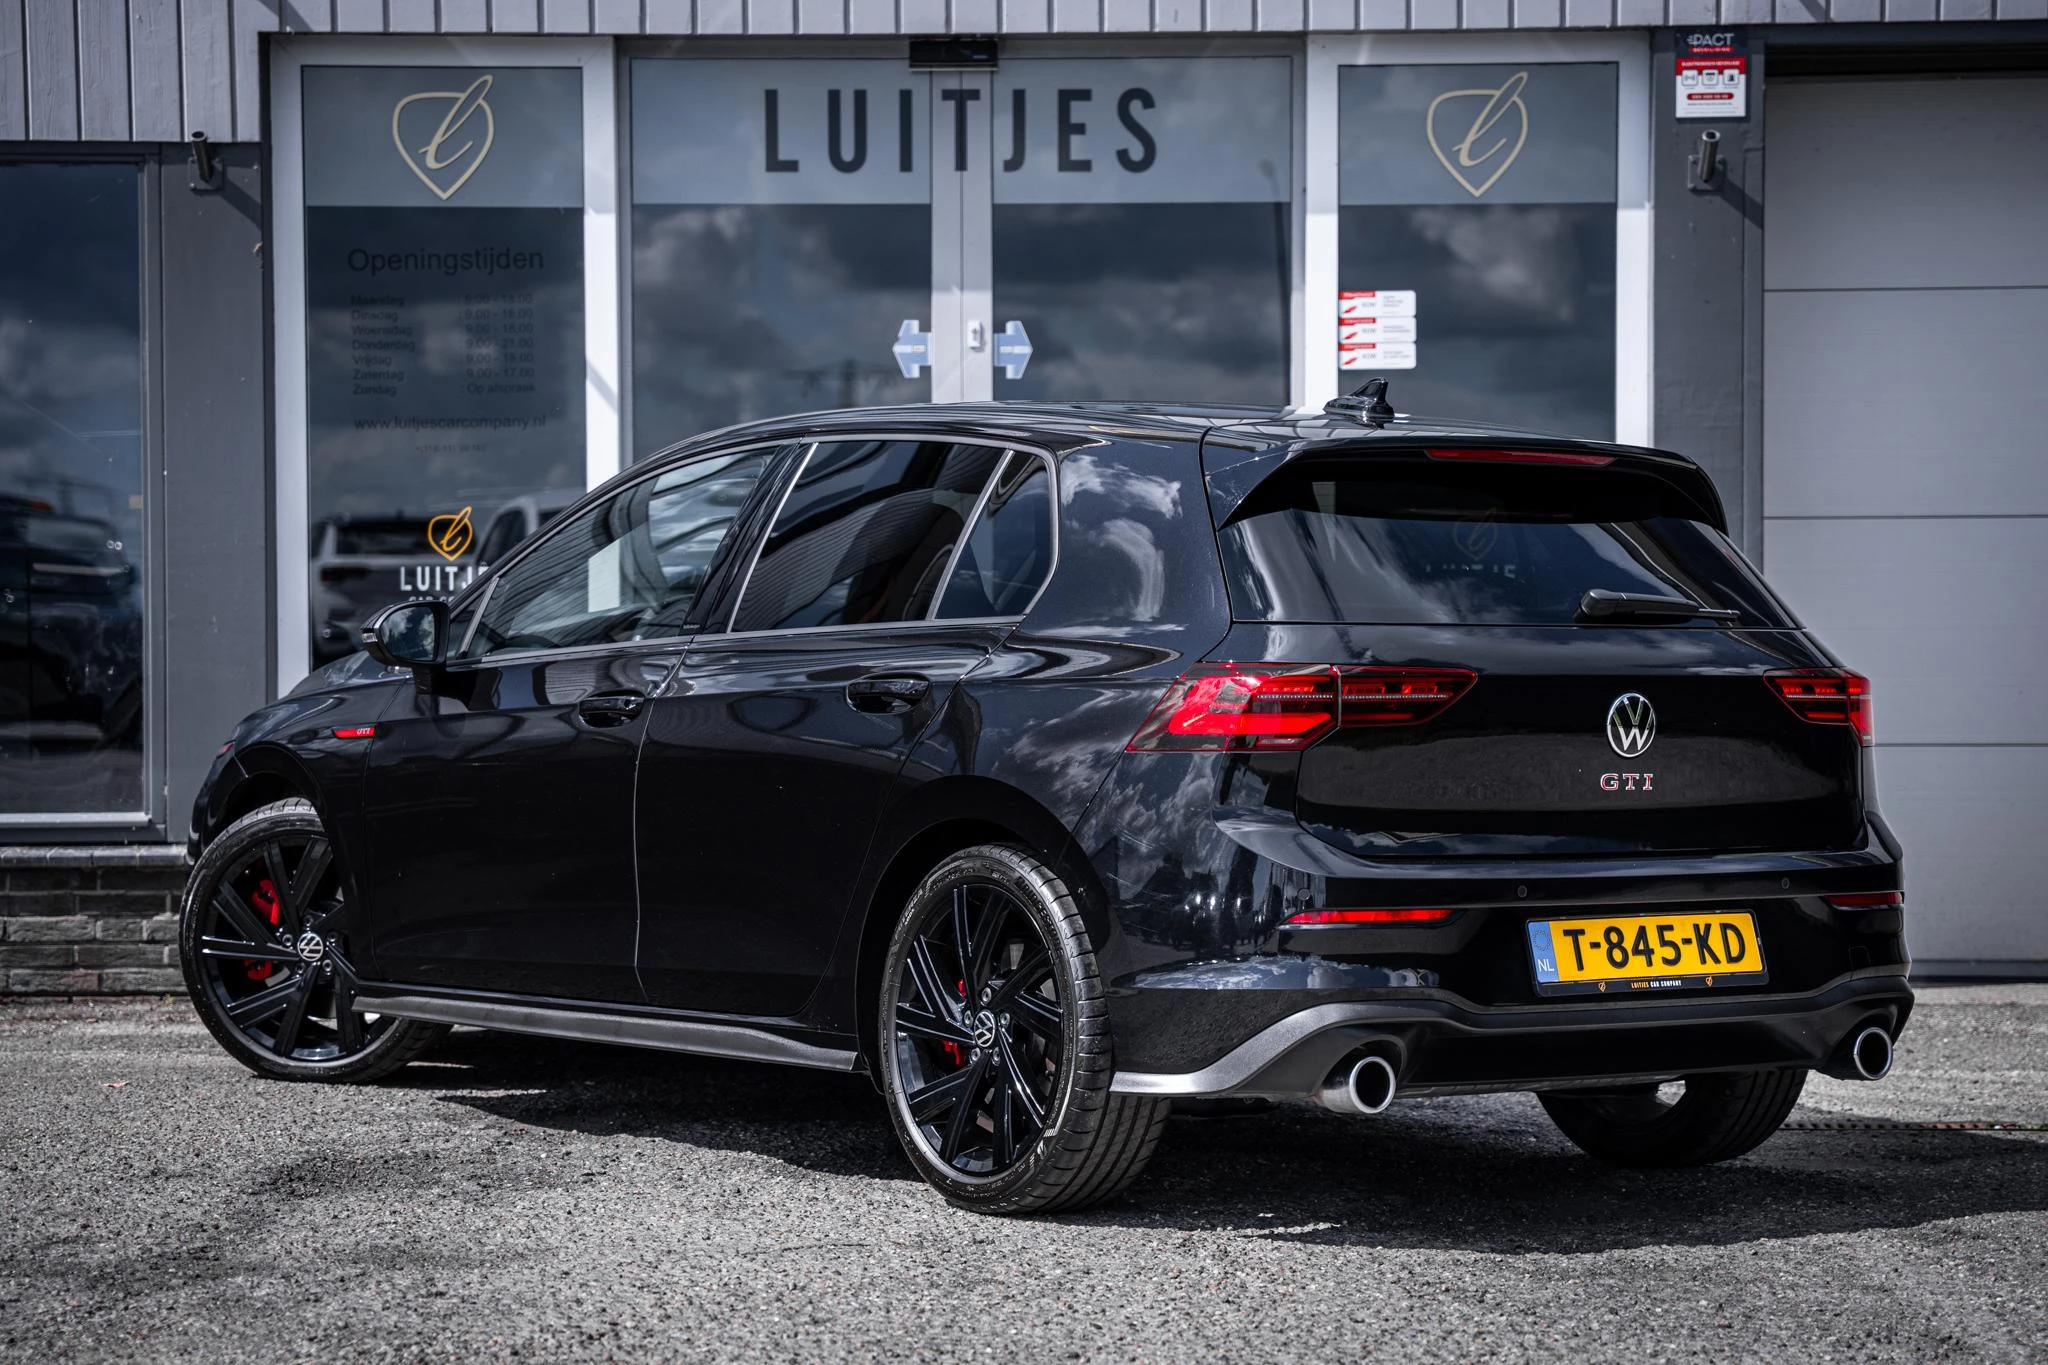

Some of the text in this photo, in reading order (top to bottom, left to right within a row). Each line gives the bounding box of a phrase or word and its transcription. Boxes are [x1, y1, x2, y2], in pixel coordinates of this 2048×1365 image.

[764, 88, 1156, 174] LUITJES
[347, 246, 545, 276] Openingstijden
[351, 309, 398, 322] Dinsdag
[352, 325, 413, 337] Woensdag
[352, 340, 416, 353] Donderdag
[352, 355, 392, 367] Vrijdag
[353, 370, 405, 382] Zaterdag
[353, 384, 397, 397] Zondag
[353, 414, 546, 432] www.luitjescarcompany.nl
[400, 565, 490, 592] LUITJ
[1600, 773, 1654, 791] GTI
[1562, 922, 1747, 972] T-845-KD
[1537, 958, 1555, 973] NL
[1650, 980, 1660, 988] CAR
